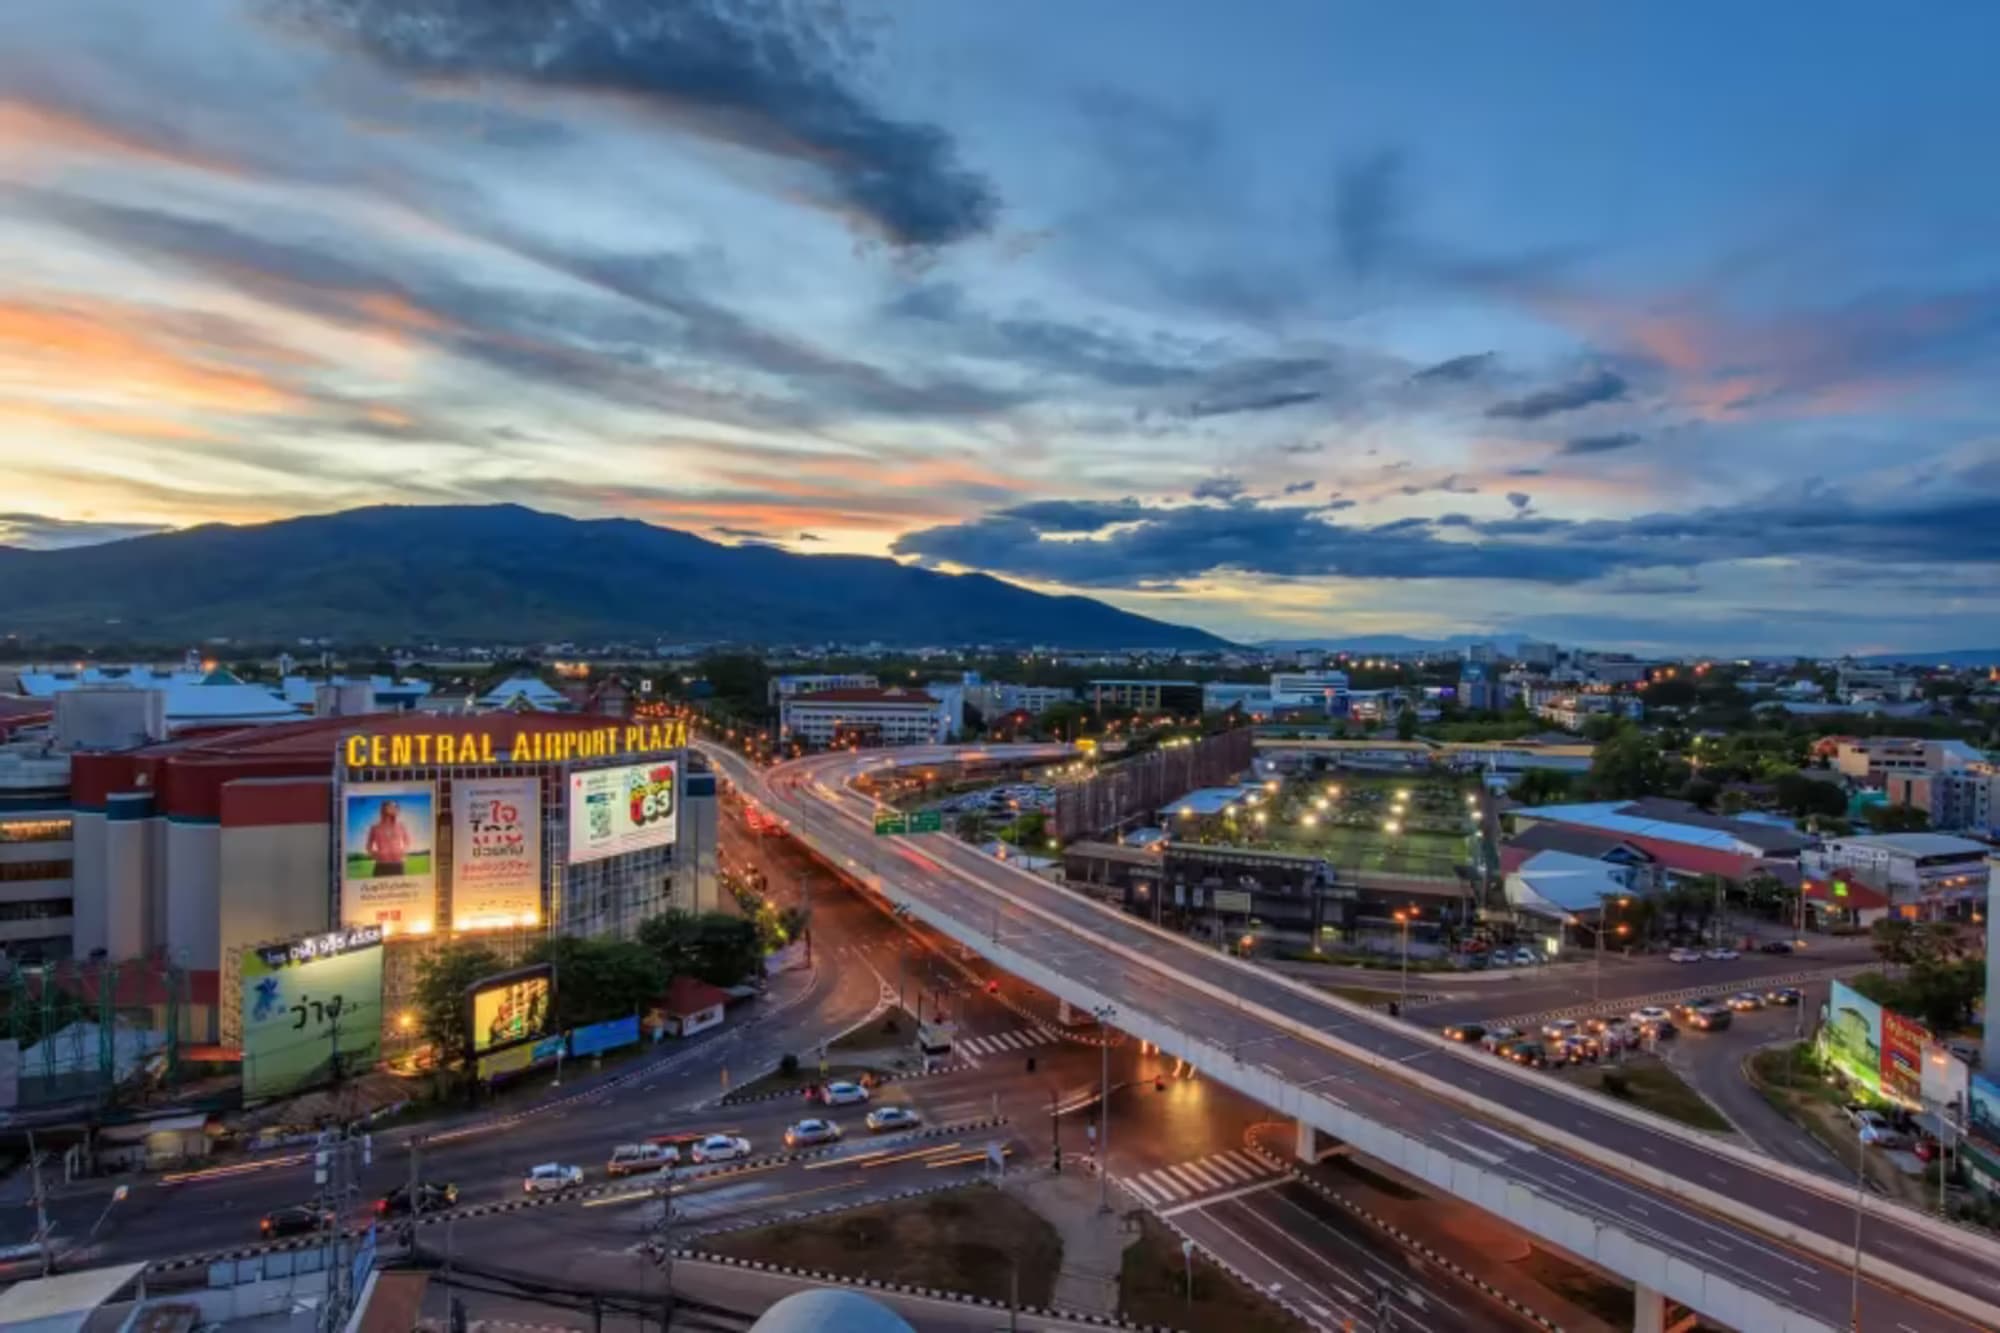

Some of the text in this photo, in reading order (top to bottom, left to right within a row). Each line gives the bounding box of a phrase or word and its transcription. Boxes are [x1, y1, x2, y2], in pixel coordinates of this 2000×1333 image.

[346, 720, 688, 767] CENTRAL AIRPORT PLAZA
